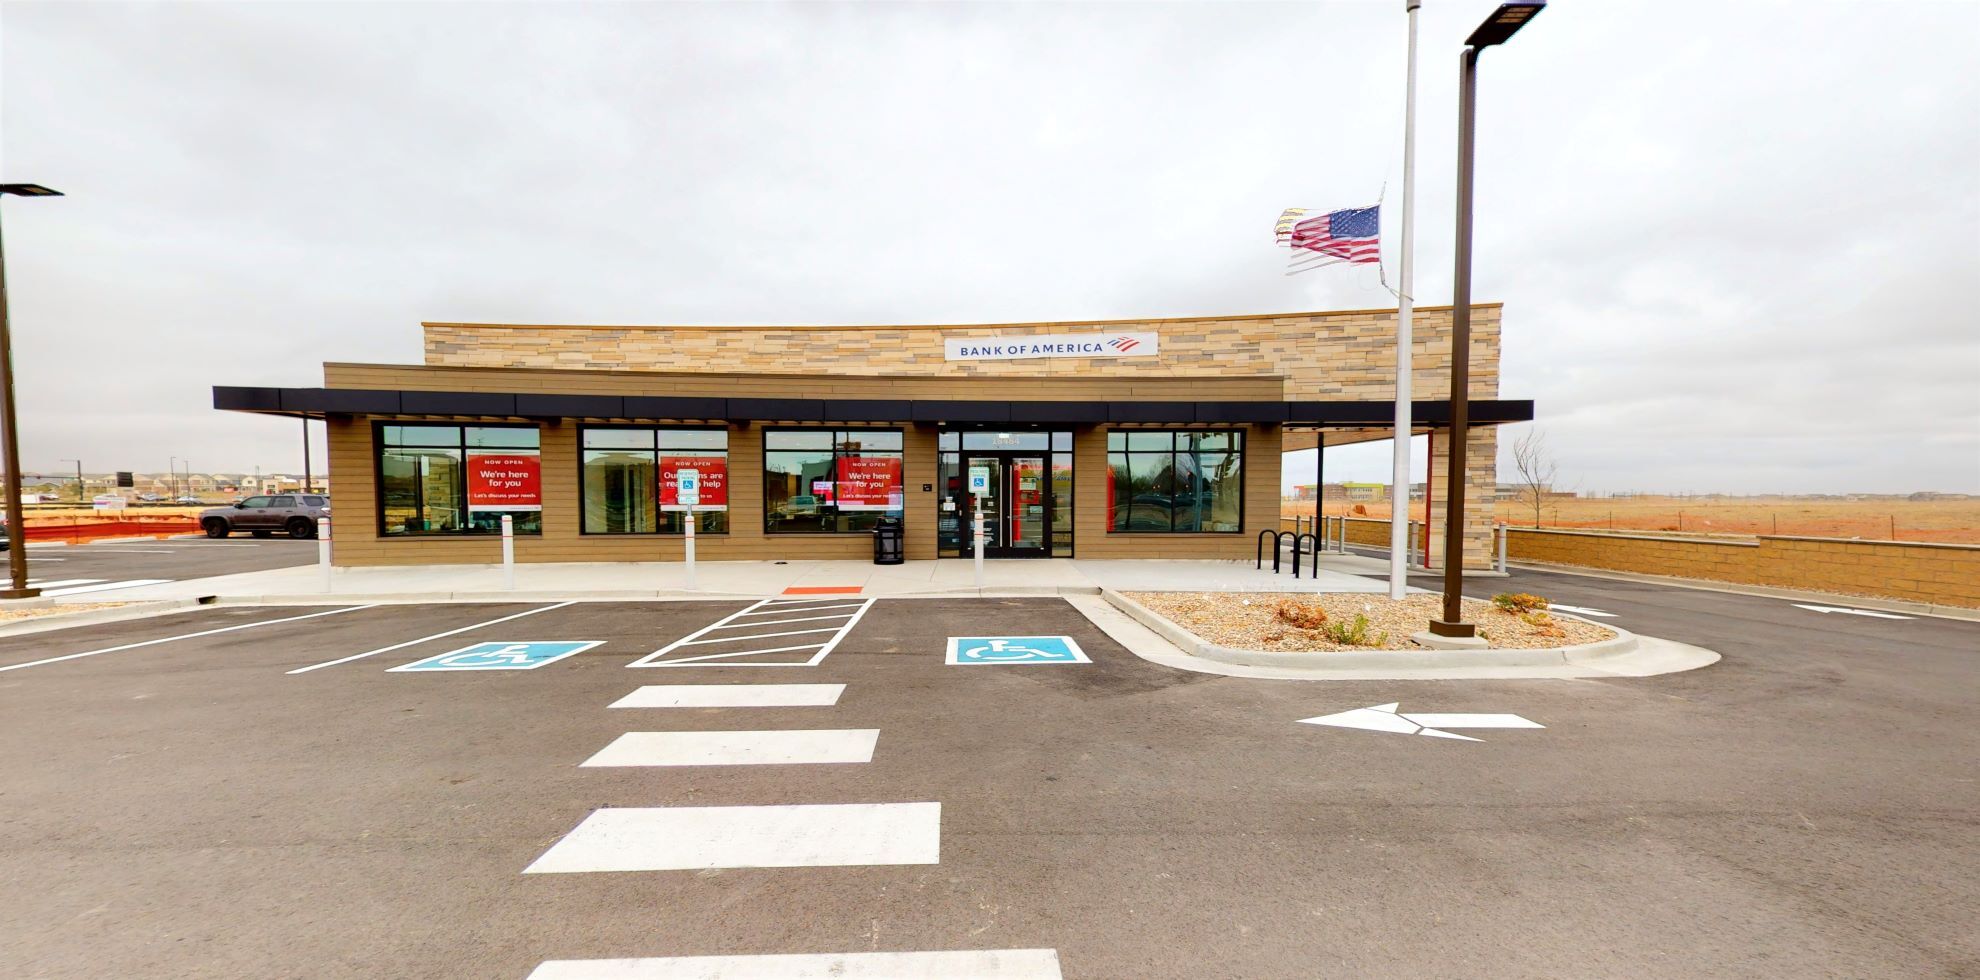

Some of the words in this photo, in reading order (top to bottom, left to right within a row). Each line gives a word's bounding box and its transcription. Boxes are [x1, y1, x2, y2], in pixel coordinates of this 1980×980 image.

[960, 346, 1002, 356] BANK
[1007, 345, 1027, 355] OF
[1031, 343, 1103, 354] AMERICA
[480, 470, 506, 478] We're
[508, 470, 529, 478] here
[848, 472, 871, 480] We're
[872, 472, 891, 480] here
[489, 479, 503, 487] for
[703, 480, 721, 489] help
[855, 480, 867, 488] for
